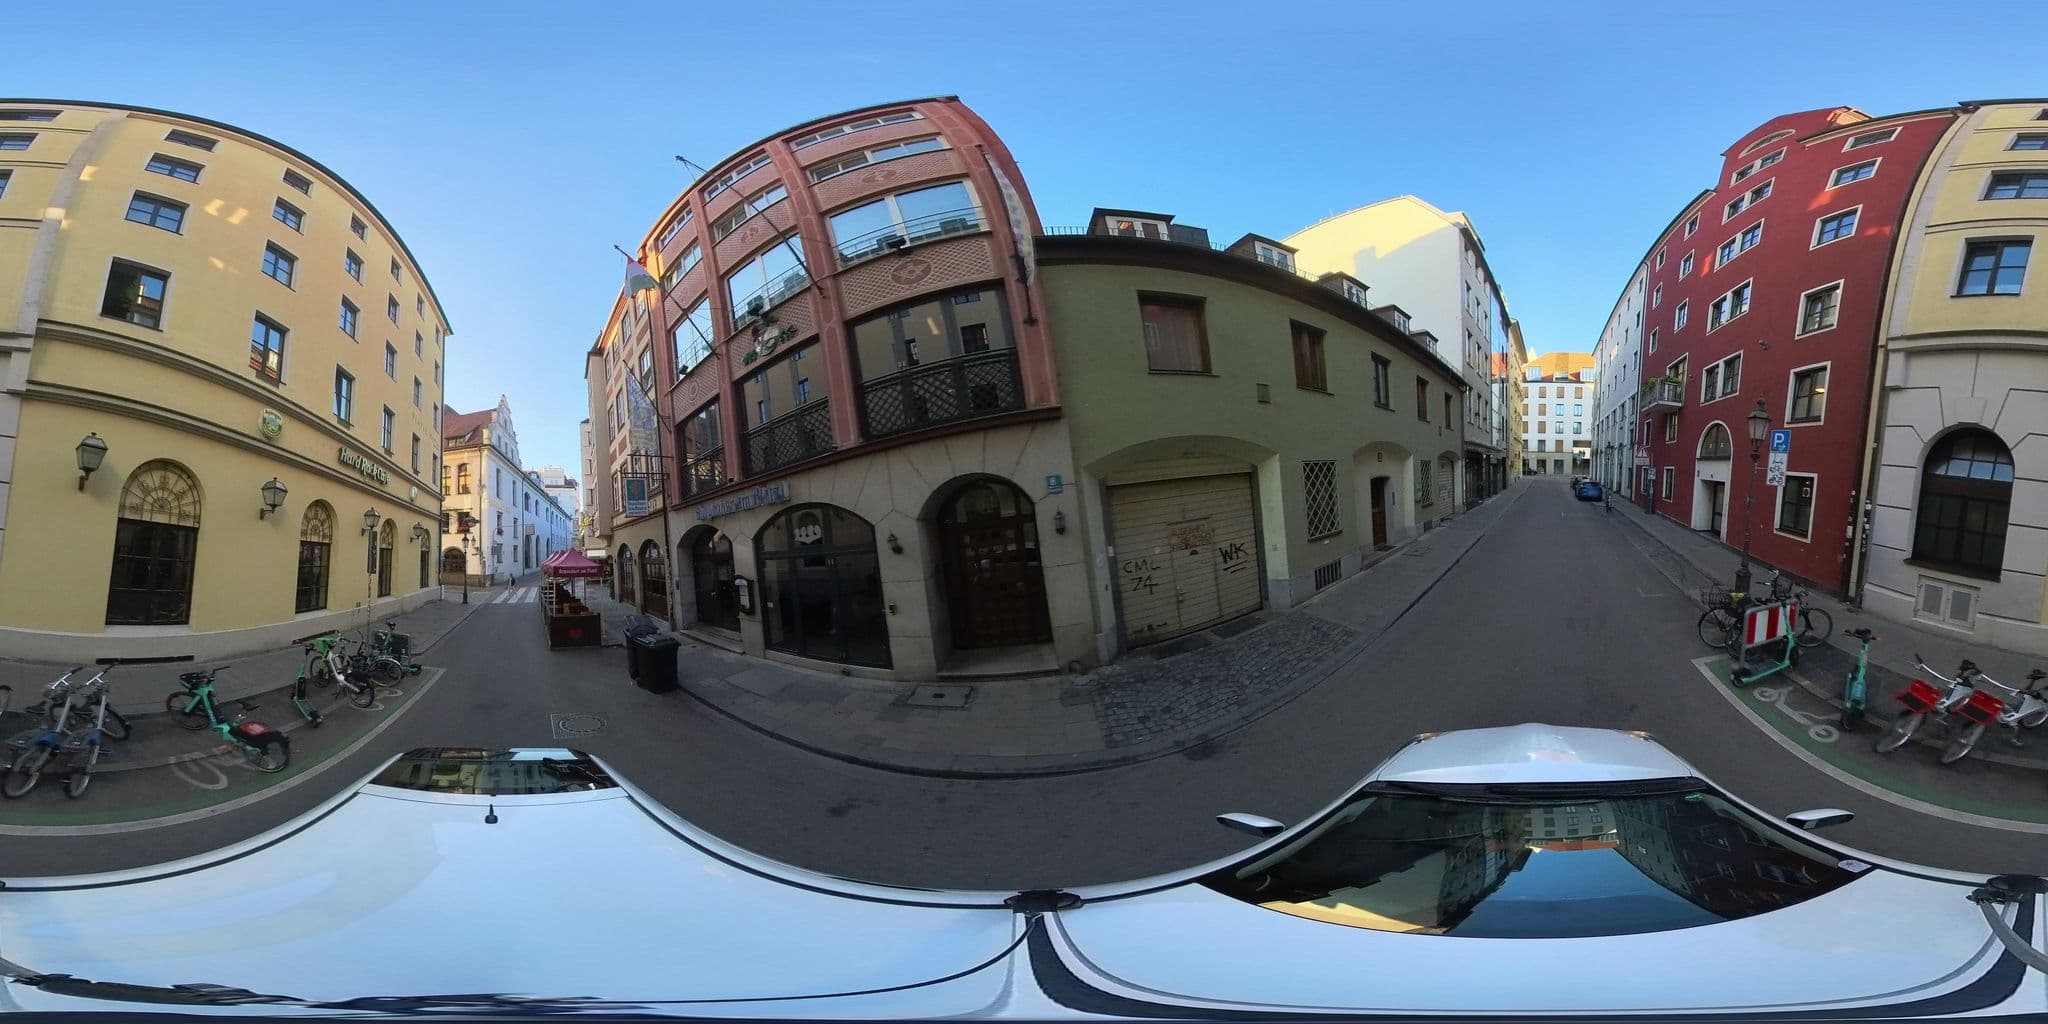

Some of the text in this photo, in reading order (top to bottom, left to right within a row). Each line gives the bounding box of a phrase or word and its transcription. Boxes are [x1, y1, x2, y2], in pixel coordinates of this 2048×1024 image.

[1774, 433, 1784, 447] P
[341, 447, 361, 468] Hard
[361, 457, 377, 480] Rock
[1219, 543, 1248, 563] WK
[1123, 560, 1160, 573] CML
